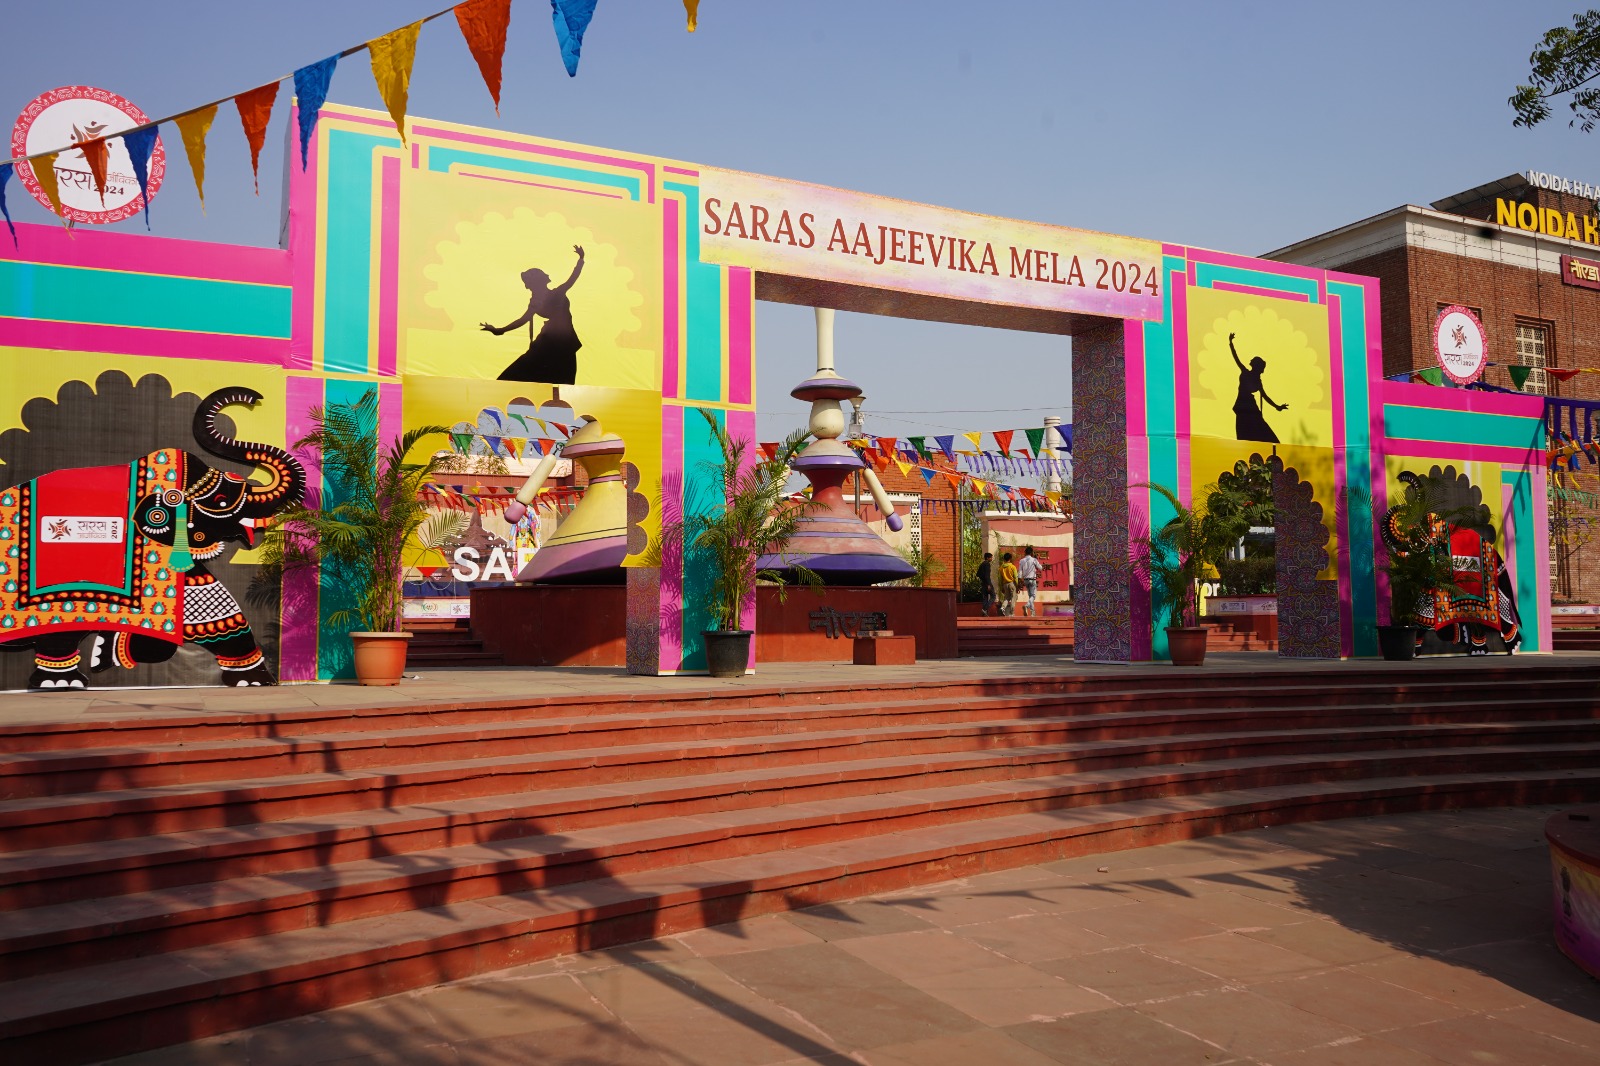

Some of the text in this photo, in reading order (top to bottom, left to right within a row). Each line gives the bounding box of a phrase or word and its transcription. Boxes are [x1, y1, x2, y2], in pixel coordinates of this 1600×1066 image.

[53, 166, 92, 190] रस
[1529, 169, 1571, 194] NOIDA
[1496, 197, 1581, 242] NOIDA
[704, 197, 1159, 297] SARAS AAJEEVIKA MELA 2024
[76, 520, 107, 532] सरस
